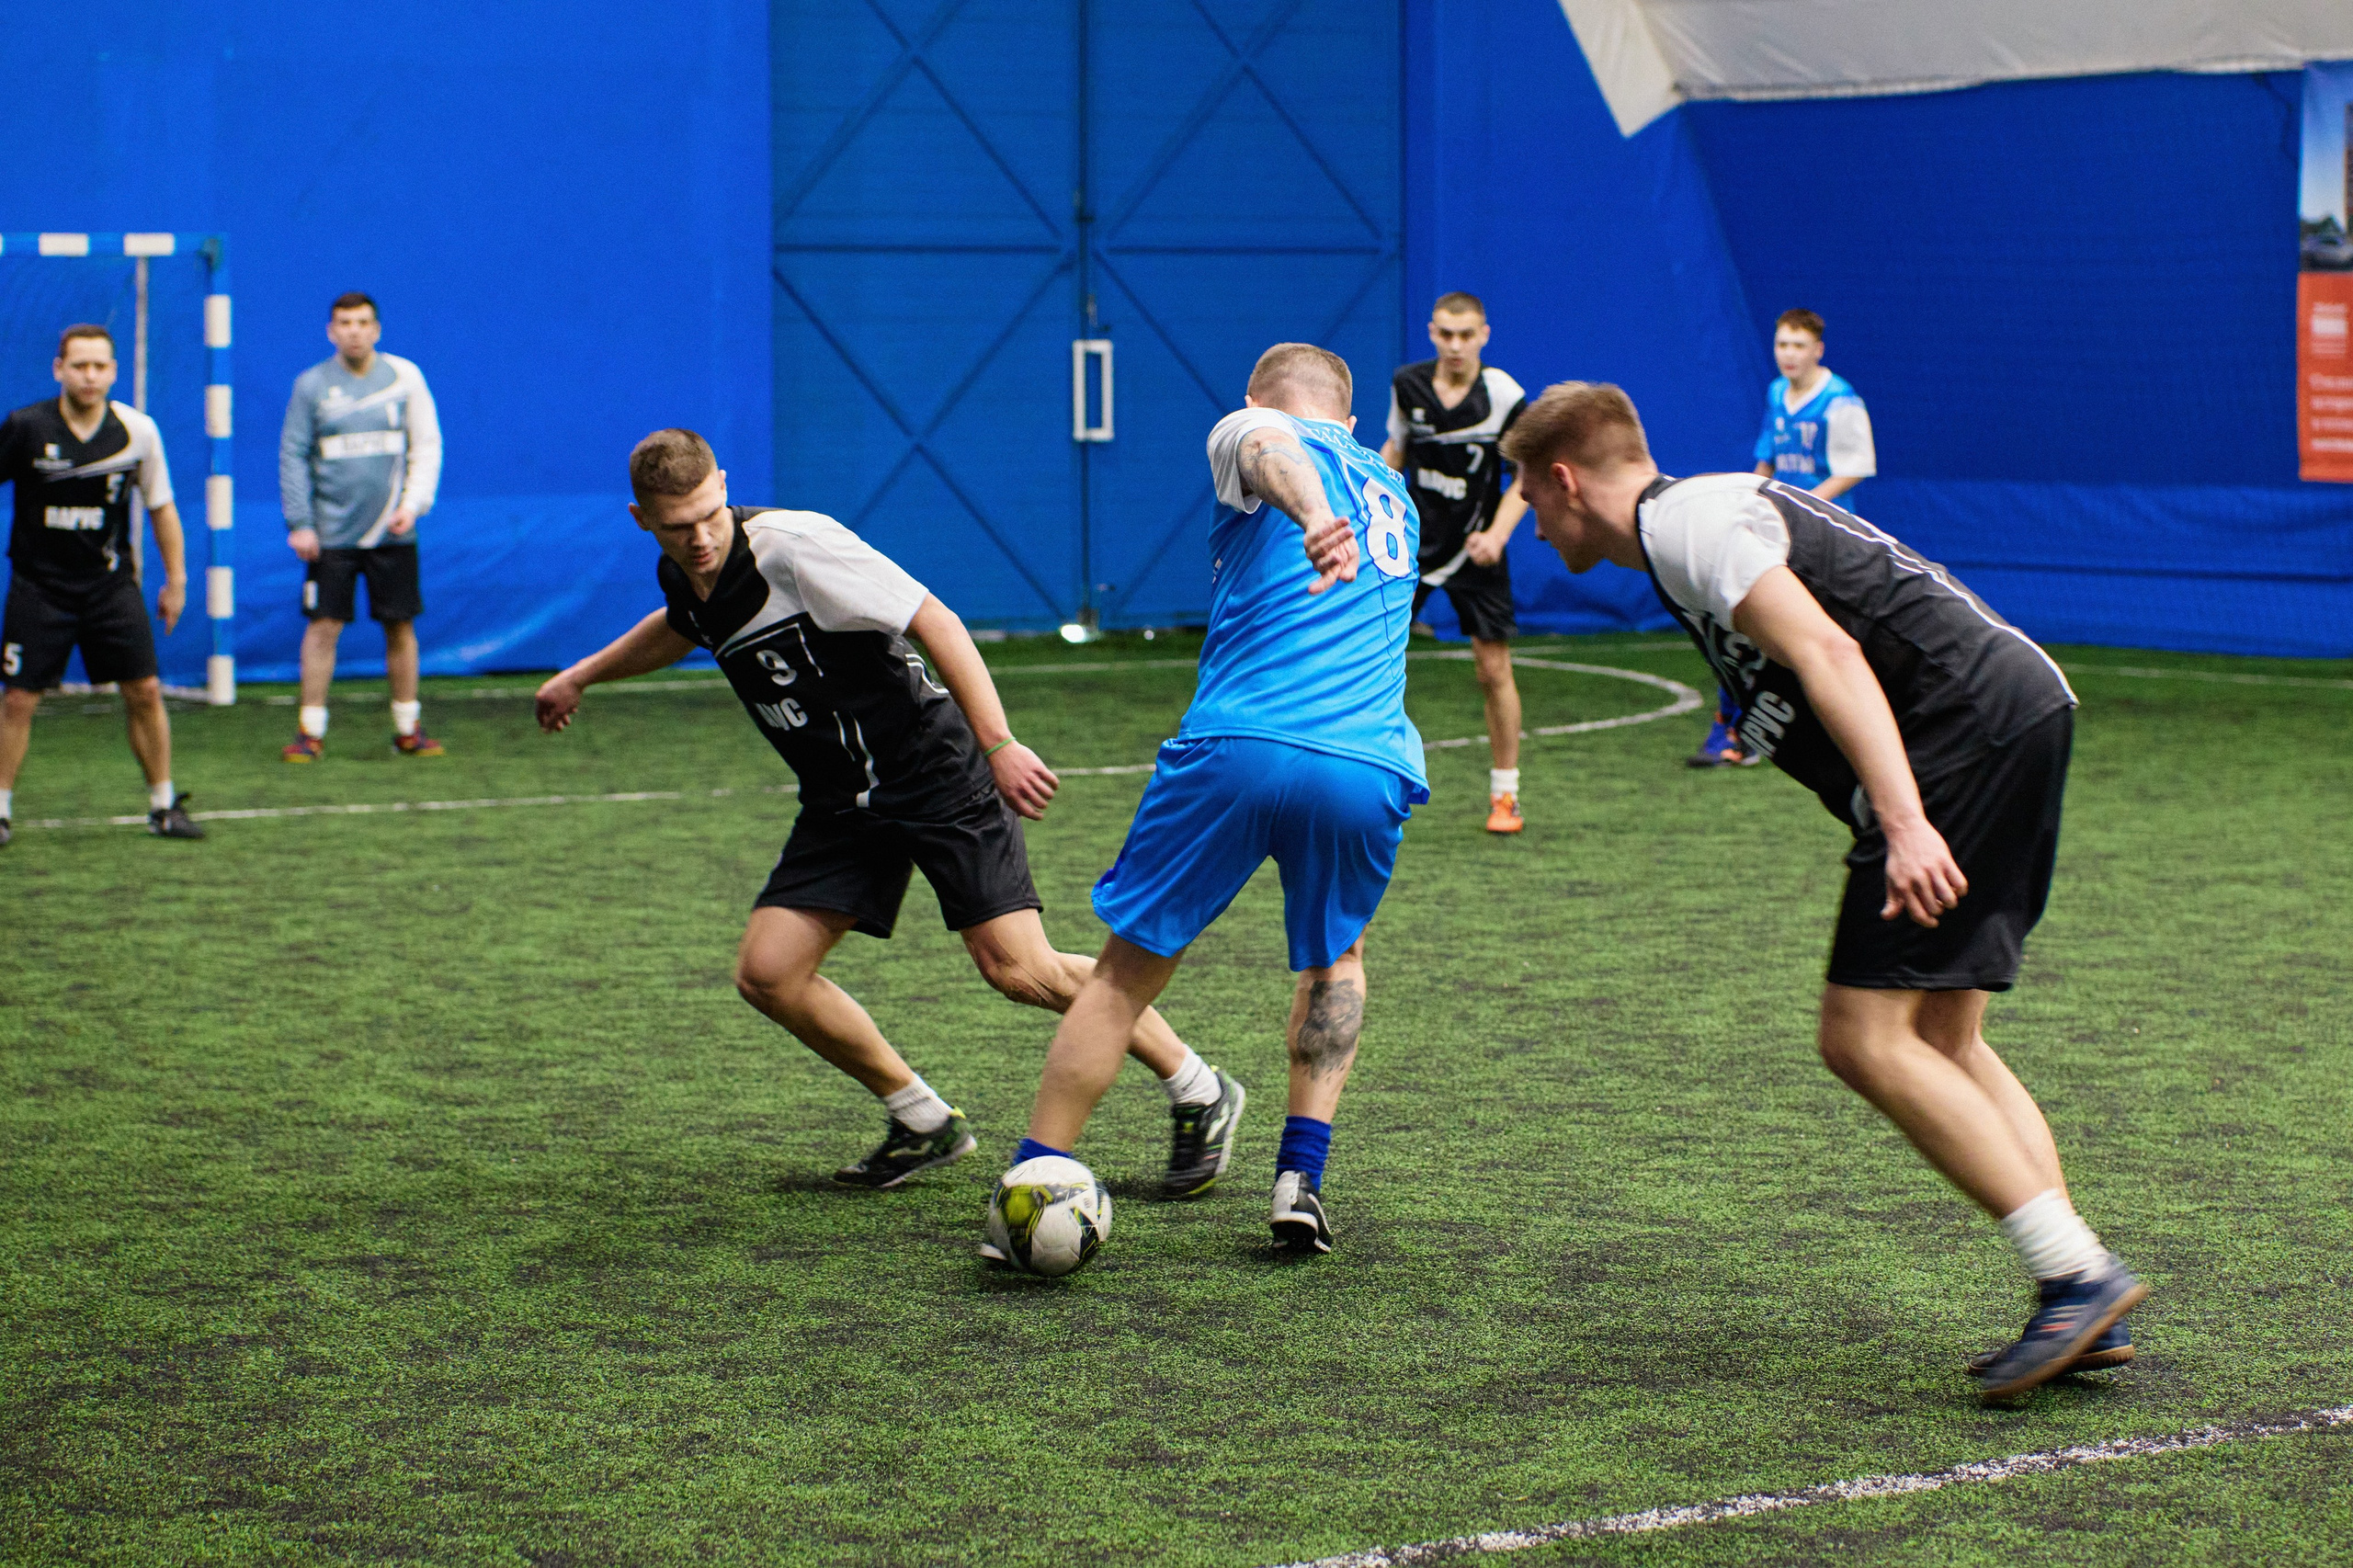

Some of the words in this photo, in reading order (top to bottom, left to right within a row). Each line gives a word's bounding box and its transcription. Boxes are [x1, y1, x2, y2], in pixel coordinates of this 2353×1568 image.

[1466, 444, 1484, 474] 7
[1362, 477, 1411, 578] 8
[4, 642, 23, 676] 5
[756, 650, 798, 687] 9
